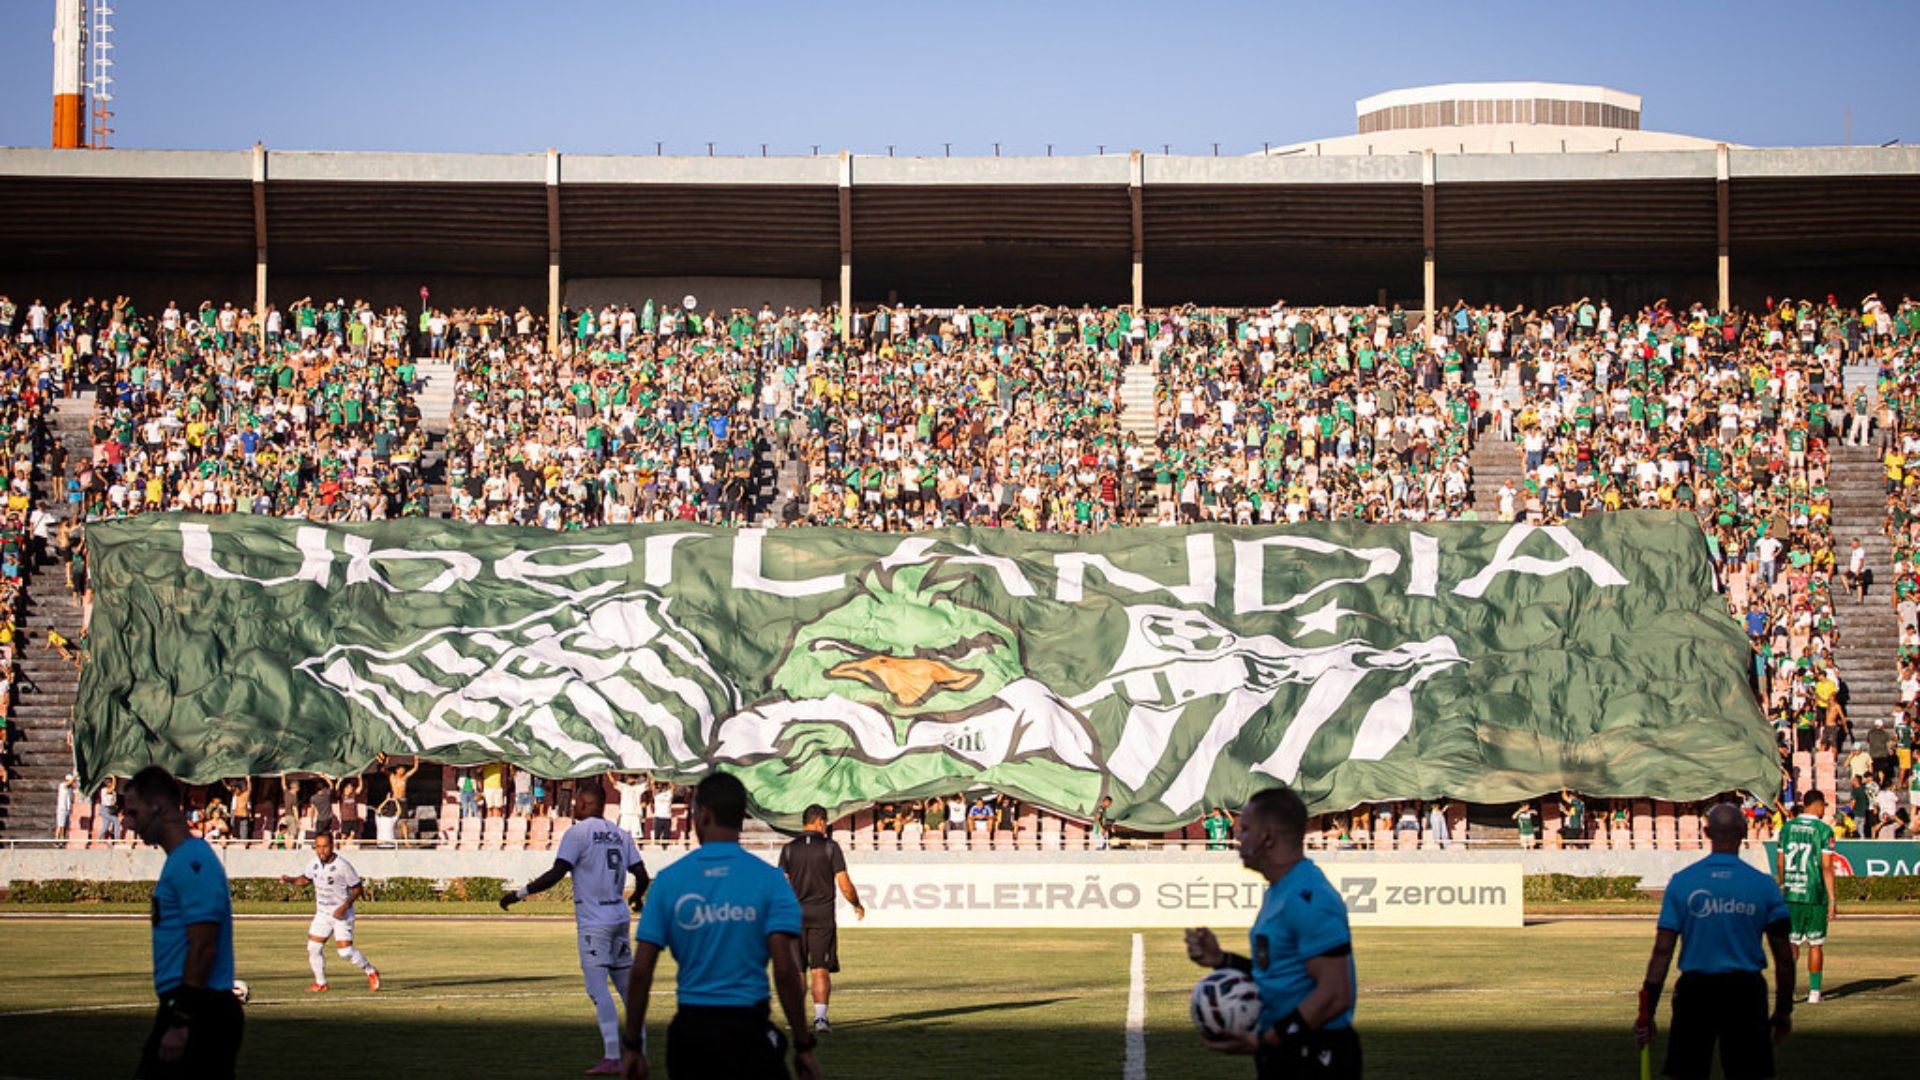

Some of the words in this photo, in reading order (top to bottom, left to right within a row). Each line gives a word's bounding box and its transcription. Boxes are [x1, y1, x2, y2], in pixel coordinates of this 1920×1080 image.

[607, 848, 622, 885] 9
[1785, 842, 1812, 872] 27
[838, 876, 1141, 909] RASILEIRÃO
[1157, 876, 1266, 909] SÉRI
[1385, 884, 1506, 905] zeroum
[1690, 892, 1755, 916] Midea
[678, 896, 756, 926] Midea
